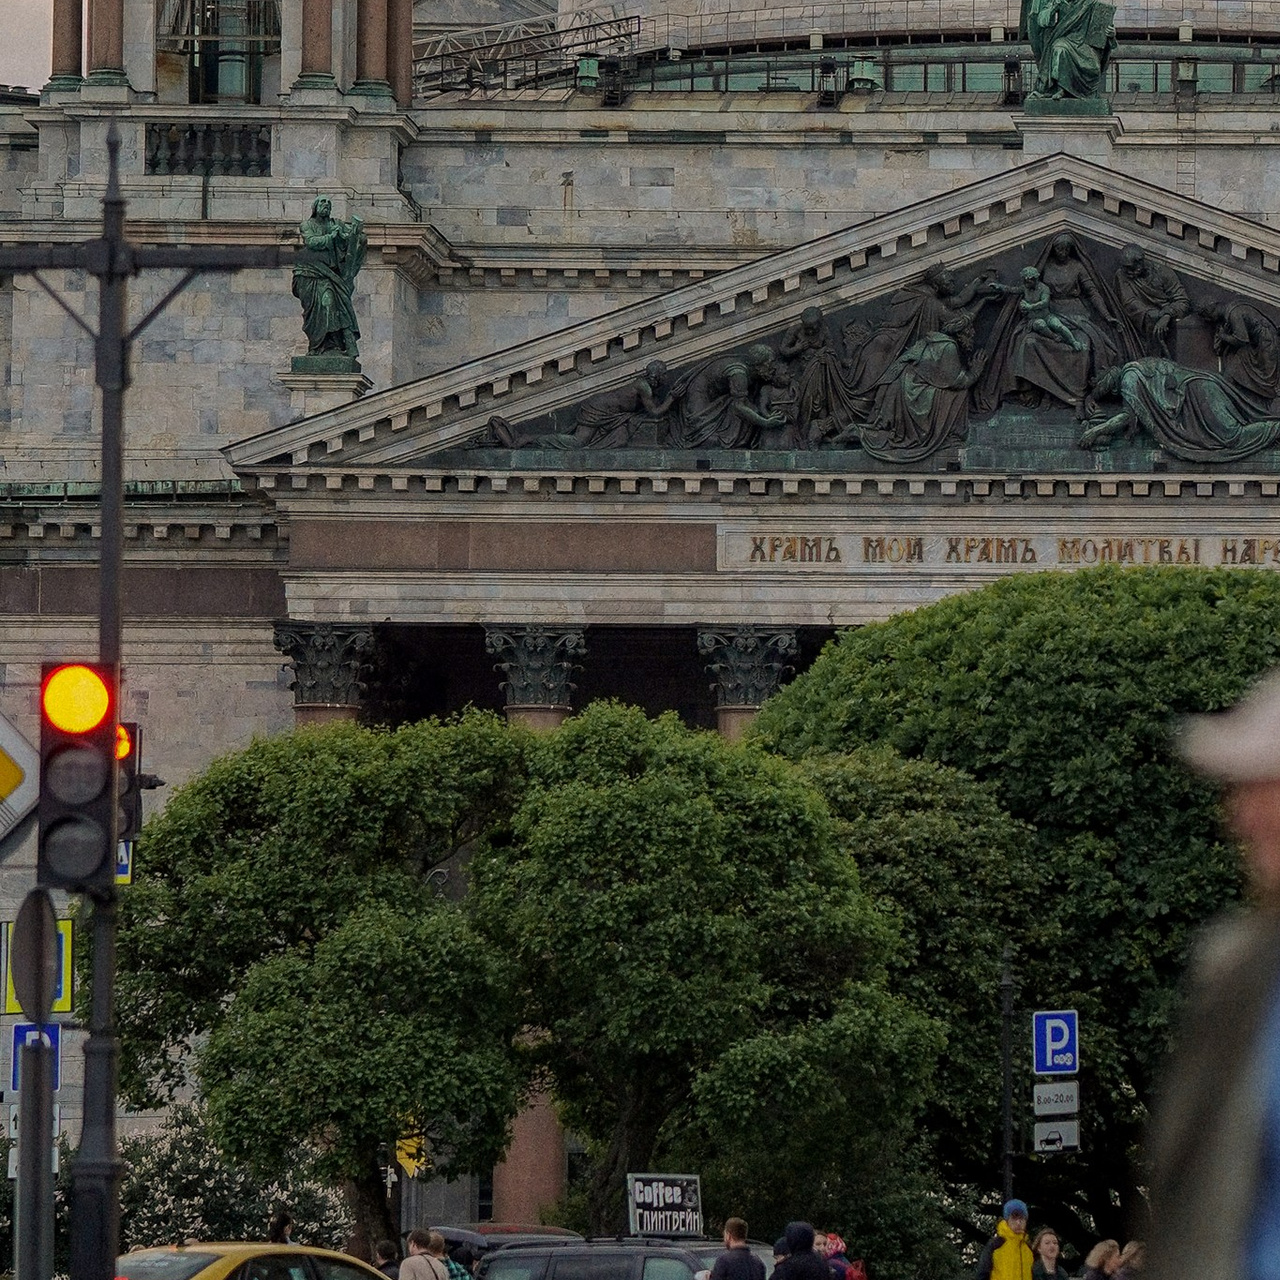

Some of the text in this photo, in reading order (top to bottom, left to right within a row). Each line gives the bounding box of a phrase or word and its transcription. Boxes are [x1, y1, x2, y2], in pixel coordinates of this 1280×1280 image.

[749, 536, 842, 563] ХРАМЪ
[945, 536, 1037, 564] ХРАМЪ
[1045, 1018, 1070, 1067] P
[635, 1181, 682, 1208] Coffee
